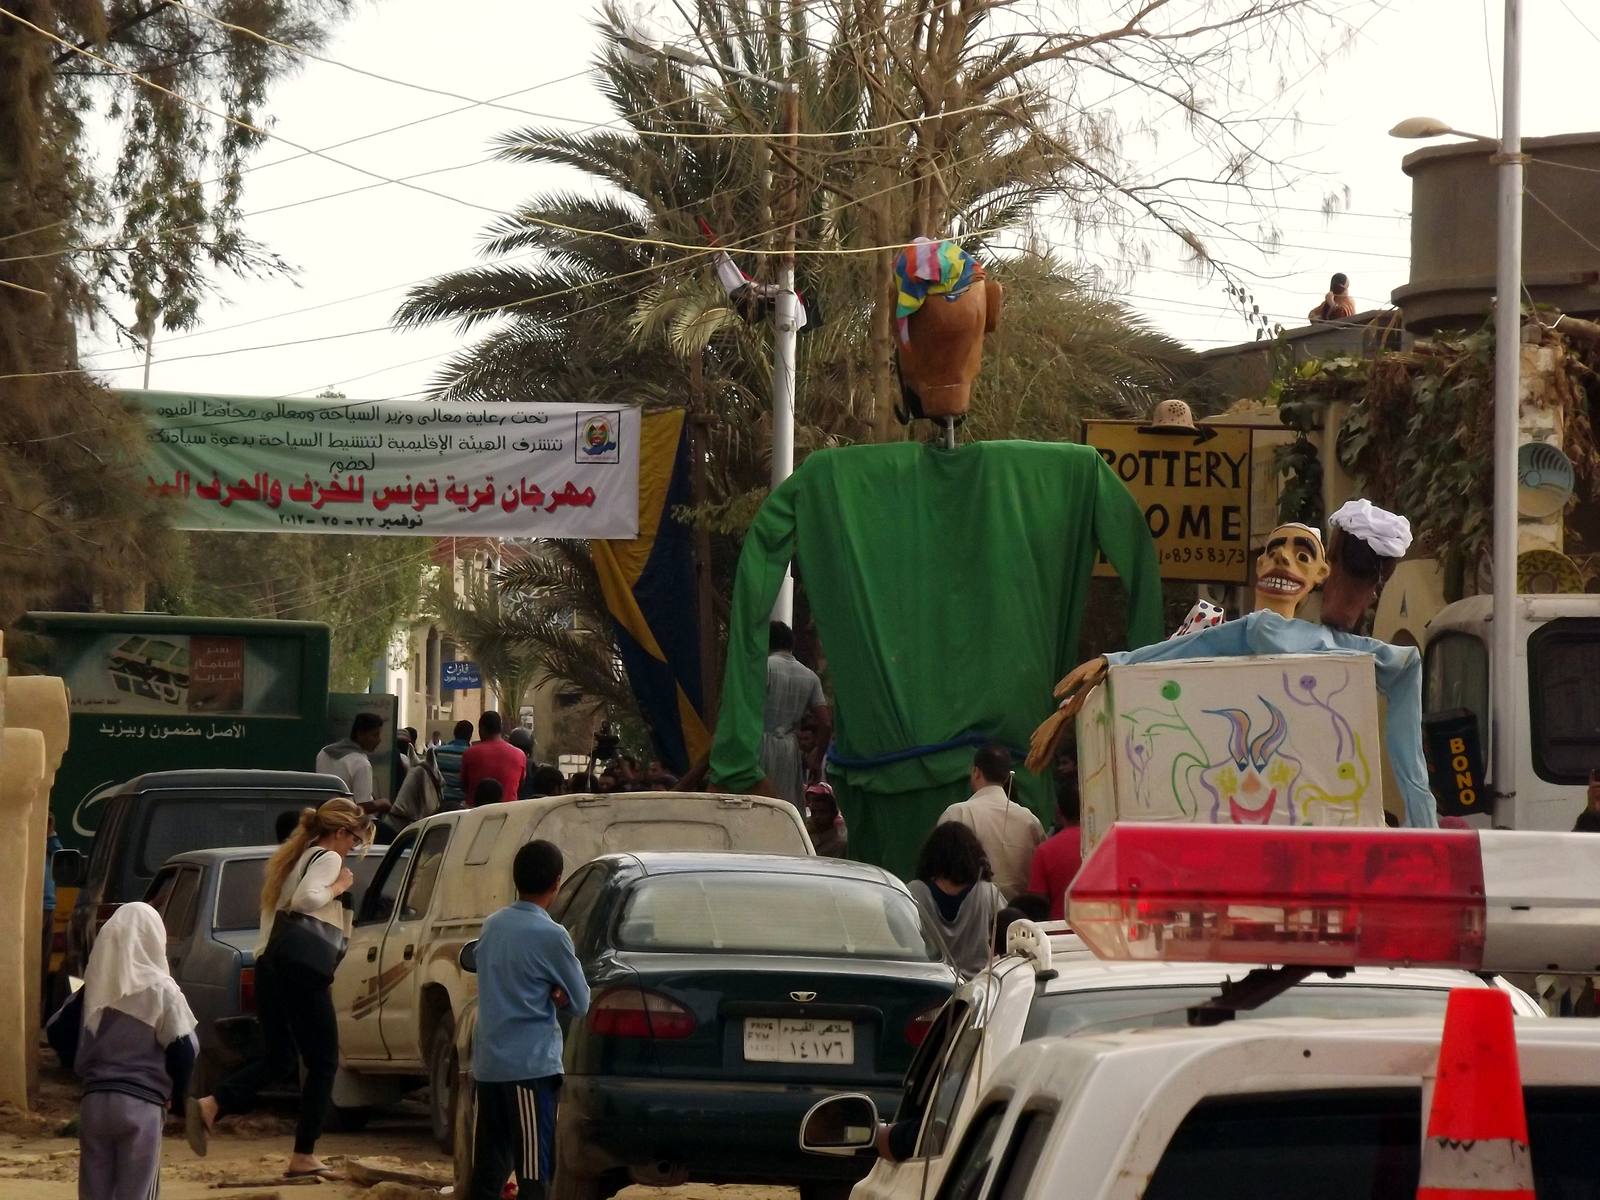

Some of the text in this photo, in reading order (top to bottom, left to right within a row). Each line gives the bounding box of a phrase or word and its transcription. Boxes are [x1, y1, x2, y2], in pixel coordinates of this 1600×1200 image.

[202, 401, 257, 418] محافظ
[319, 405, 380, 424] السياحة
[385, 410, 413, 425] وزير
[466, 409, 504, 426] رعاية
[511, 413, 548, 425] تحت
[210, 432, 255, 448] بدعوة
[259, 431, 322, 450] السياحة
[328, 432, 383, 452] لتنشيط
[387, 434, 452, 456] الإقليمية
[458, 434, 506, 453] الهيئة
[329, 452, 375, 473] لحضور
[196, 469, 282, 509] والحرف
[288, 472, 364, 510] للخزف
[372, 474, 439, 512] تونس
[444, 474, 496, 513] قرية
[500, 475, 596, 513] مهرجان
[378, 514, 423, 530] نوفمبر
[1144, 503, 1242, 542] OME
[149, 722, 201, 739] مضمون
[1450, 738, 1476, 806] BONO
